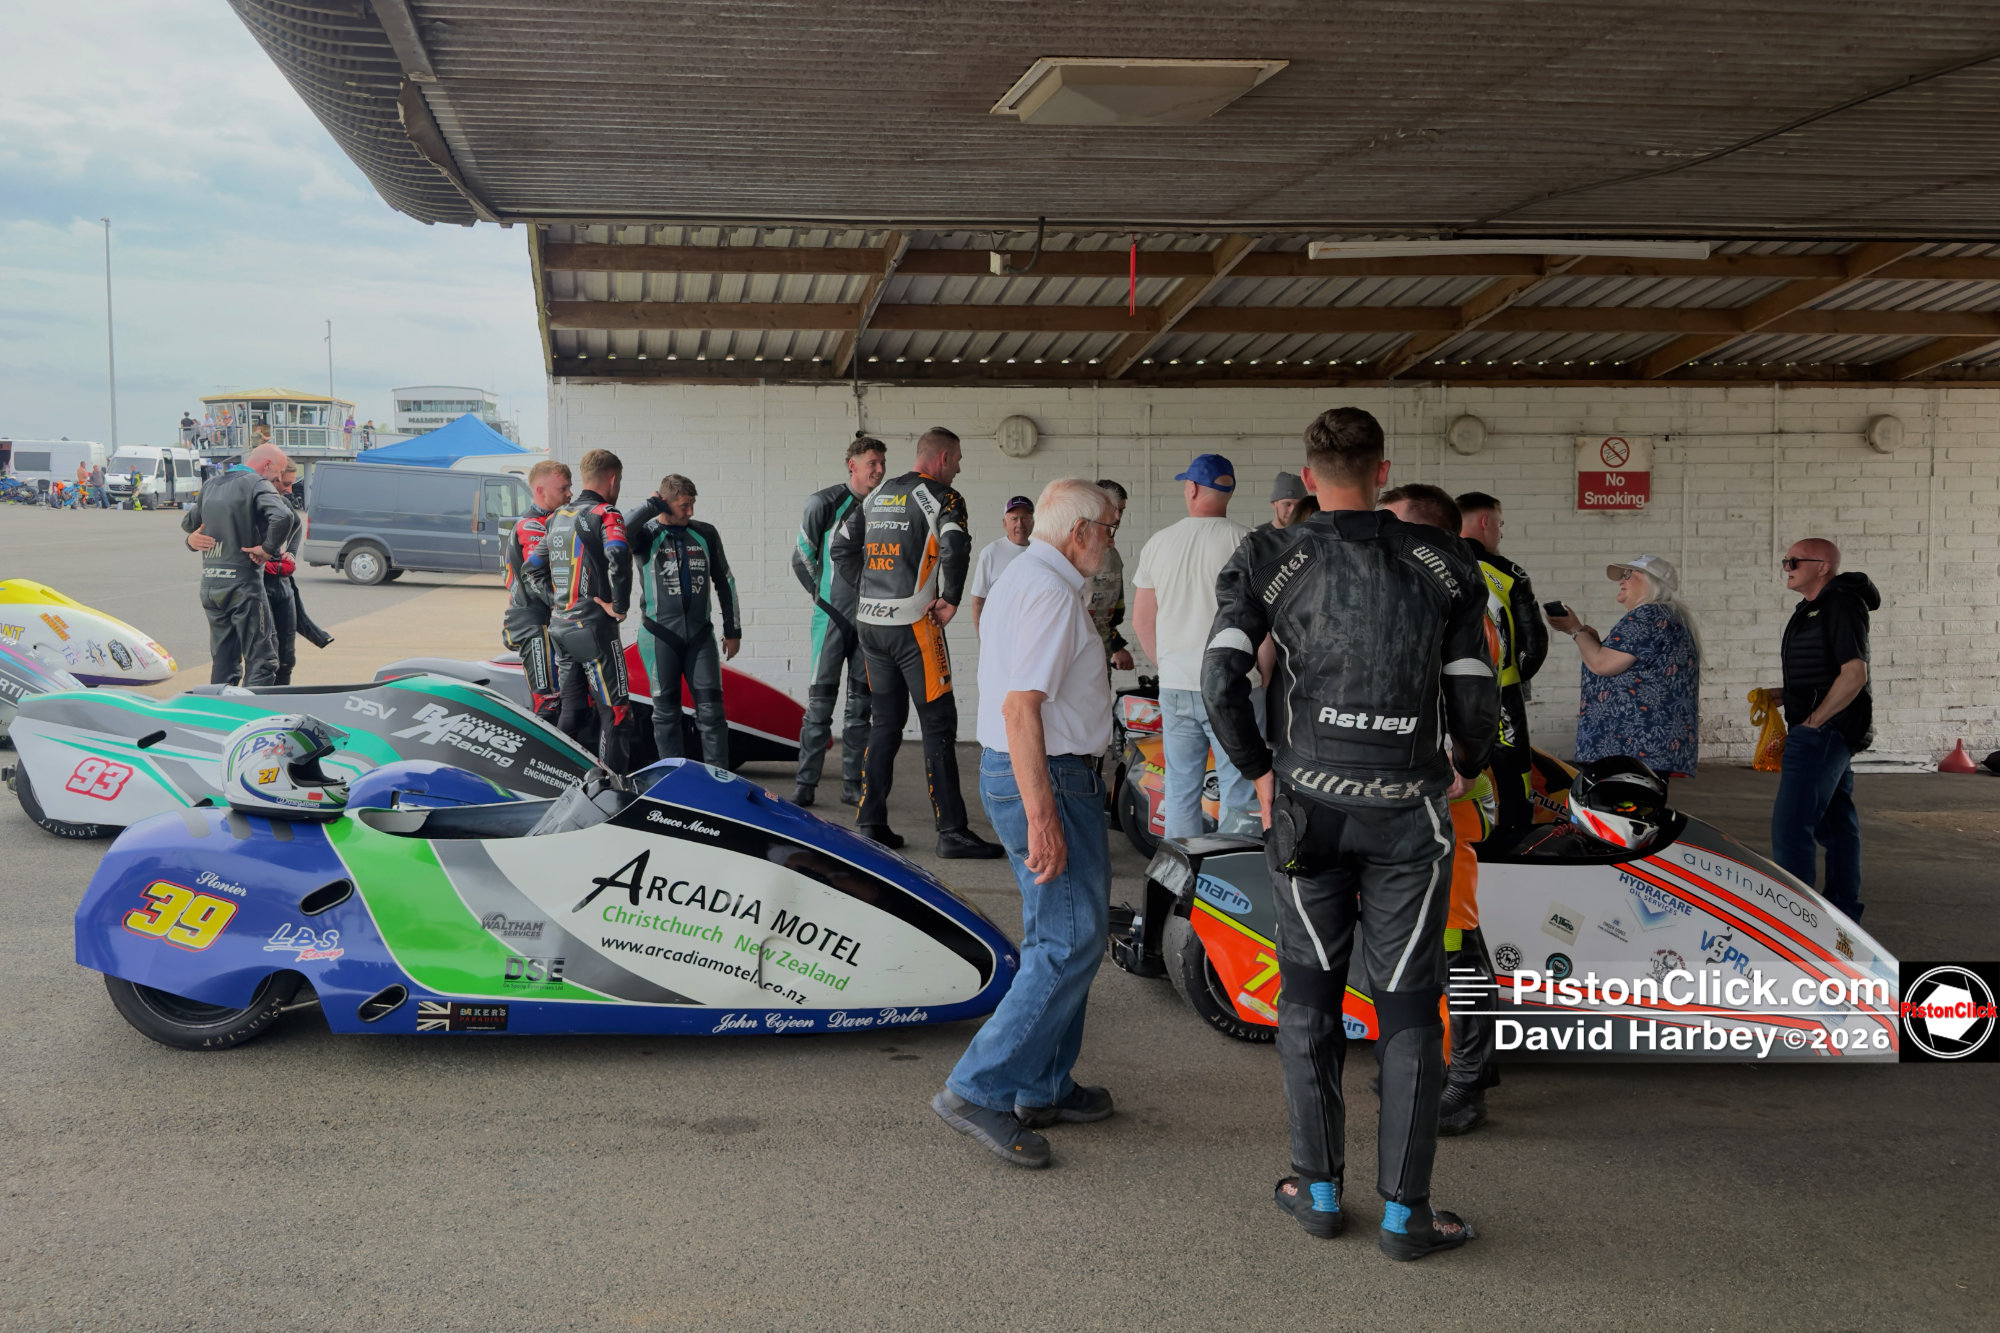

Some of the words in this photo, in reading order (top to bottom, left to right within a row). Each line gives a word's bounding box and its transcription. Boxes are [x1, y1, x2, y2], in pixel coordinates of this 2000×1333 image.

[1605, 473, 1626, 486] No
[1584, 491, 1645, 508] Smoking
[866, 542, 901, 556] TEAM
[868, 558, 895, 571] ARC
[344, 695, 397, 720] DSV
[440, 732, 515, 768] Racing
[529, 757, 536, 766] R
[66, 757, 133, 801] 93
[258, 767, 280, 785] 27
[646, 809, 683, 829] Bruce
[683, 819, 721, 838] Moore
[196, 871, 247, 898] Stonier
[1619, 873, 1693, 917] HYDRACARE
[572, 849, 762, 925] ARCADIA
[770, 909, 866, 967] MOTEL
[1629, 888, 1643, 899] OIL
[1643, 893, 1678, 916] SERVICES
[122, 879, 239, 952] 39
[482, 920, 544, 931] WALTHAM
[503, 930, 541, 938] SERVICES
[602, 905, 724, 943] Christchurch
[734, 934, 776, 961] New
[776, 950, 851, 991] Zealand
[504, 958, 565, 982] DSE
[712, 1013, 758, 1033] John
[827, 1010, 873, 1028] Dave
[876, 1007, 928, 1025] Porter
